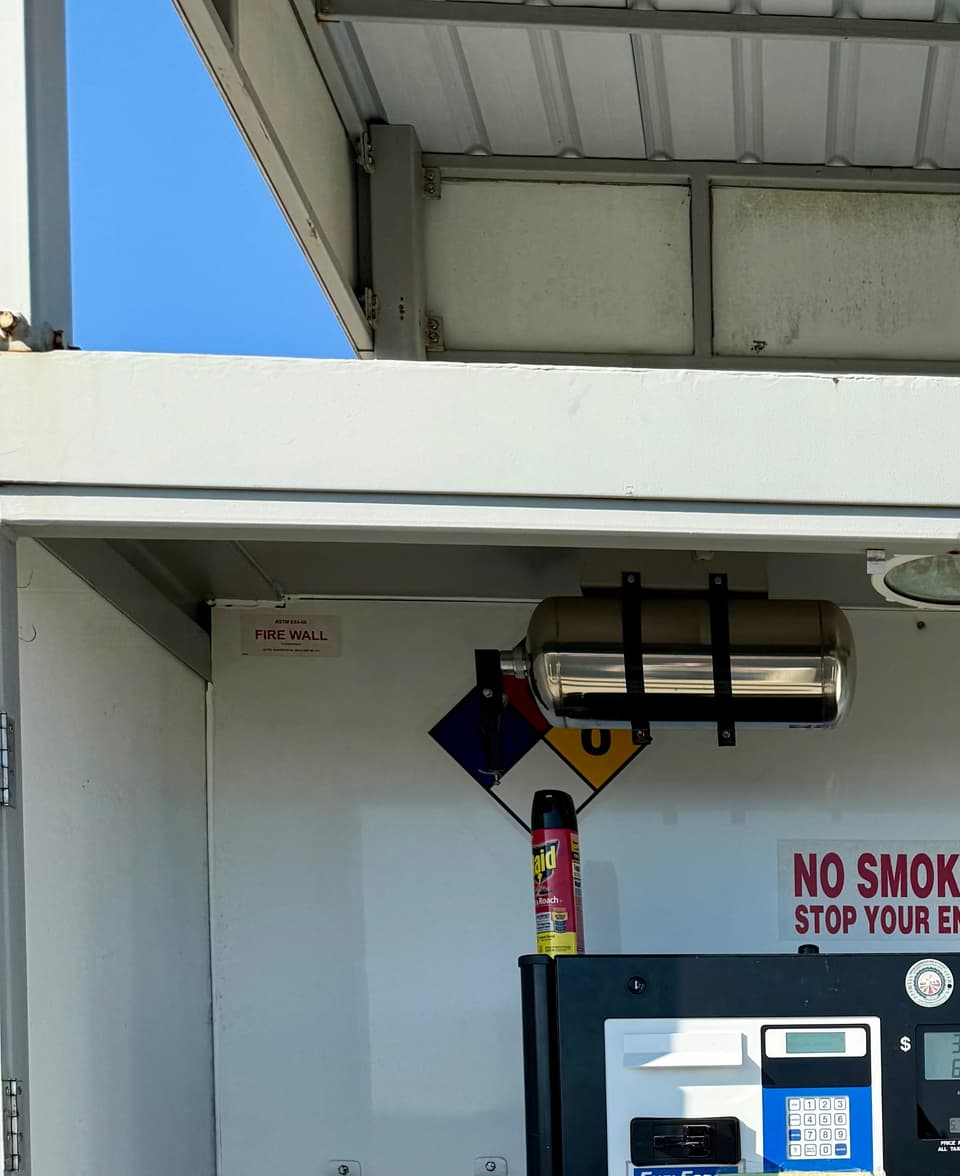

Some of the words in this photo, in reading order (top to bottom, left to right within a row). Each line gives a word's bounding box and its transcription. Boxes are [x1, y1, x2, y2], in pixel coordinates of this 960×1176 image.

[255, 629, 286, 640] FIRE
[289, 630, 328, 640] WALL
[532, 845, 557, 875] aid
[793, 852, 845, 899] NO
[794, 904, 857, 935] STOP
[864, 905, 930, 935] YOUR
[900, 1036, 912, 1052] $
